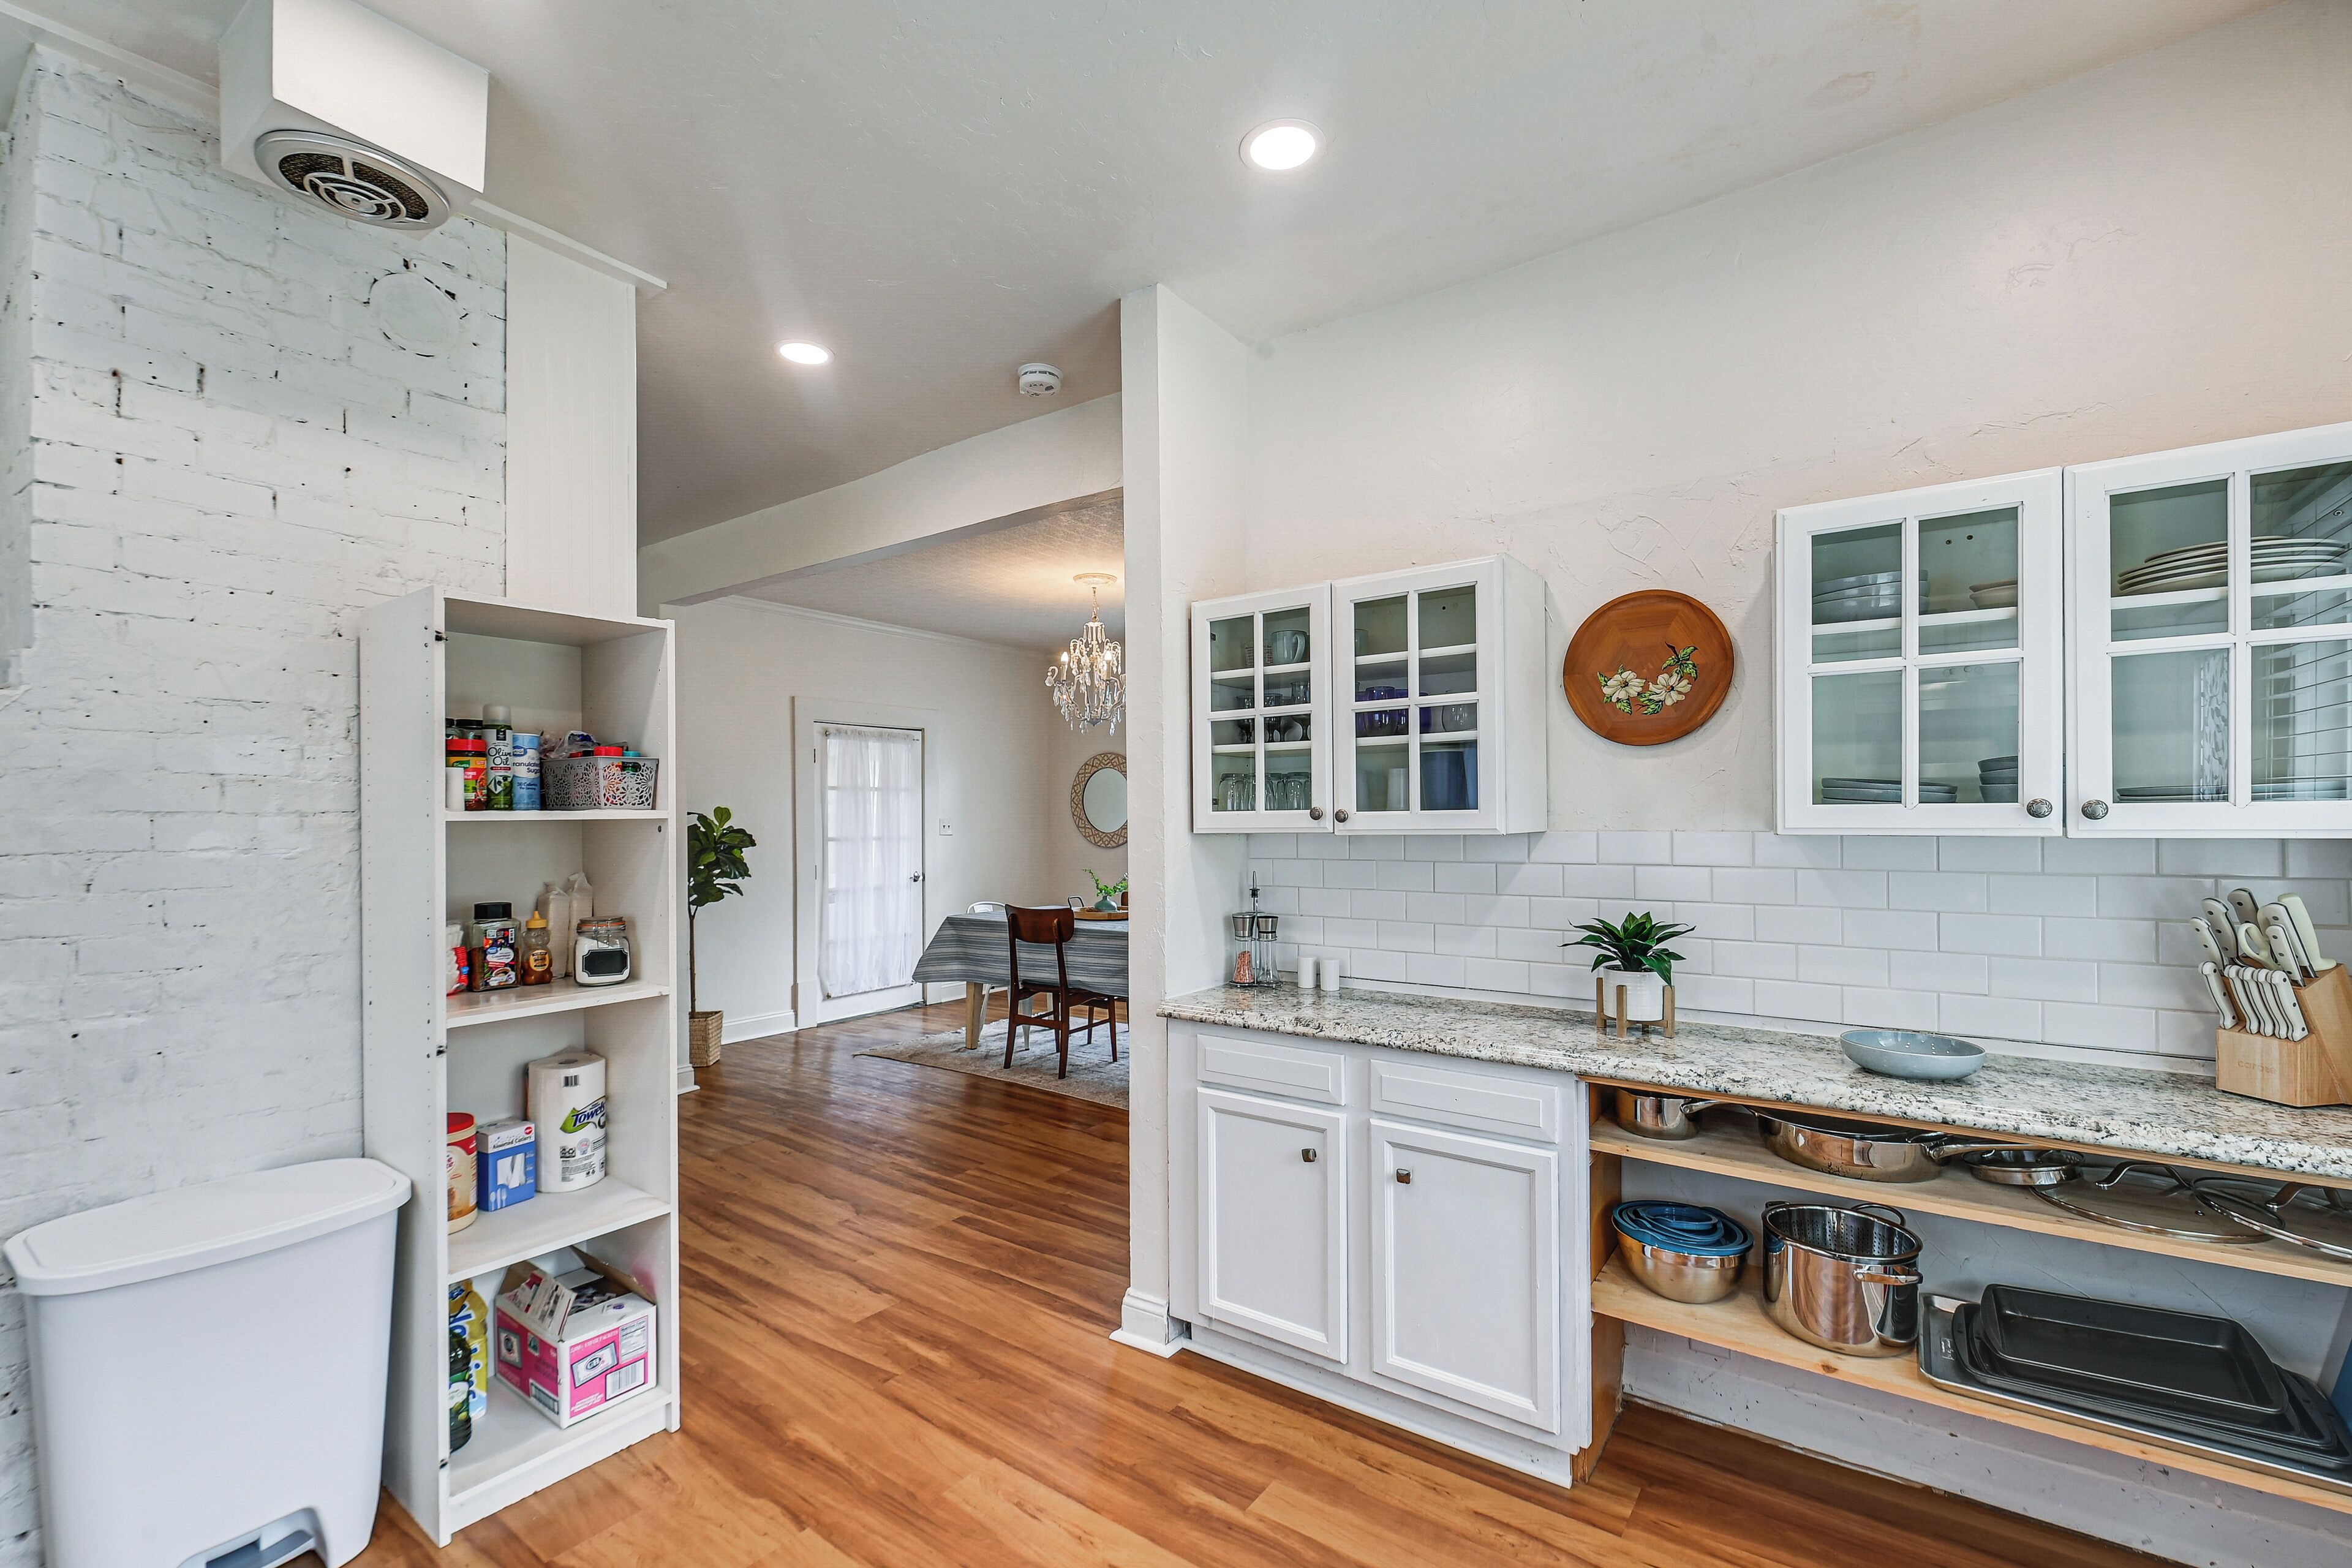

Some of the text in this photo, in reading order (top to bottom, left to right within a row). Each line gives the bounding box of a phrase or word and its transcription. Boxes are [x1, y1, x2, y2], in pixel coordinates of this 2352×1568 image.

[488, 747, 513, 757] Olive
[492, 756, 510, 766] Oil
[571, 1101, 606, 1128] Towels
